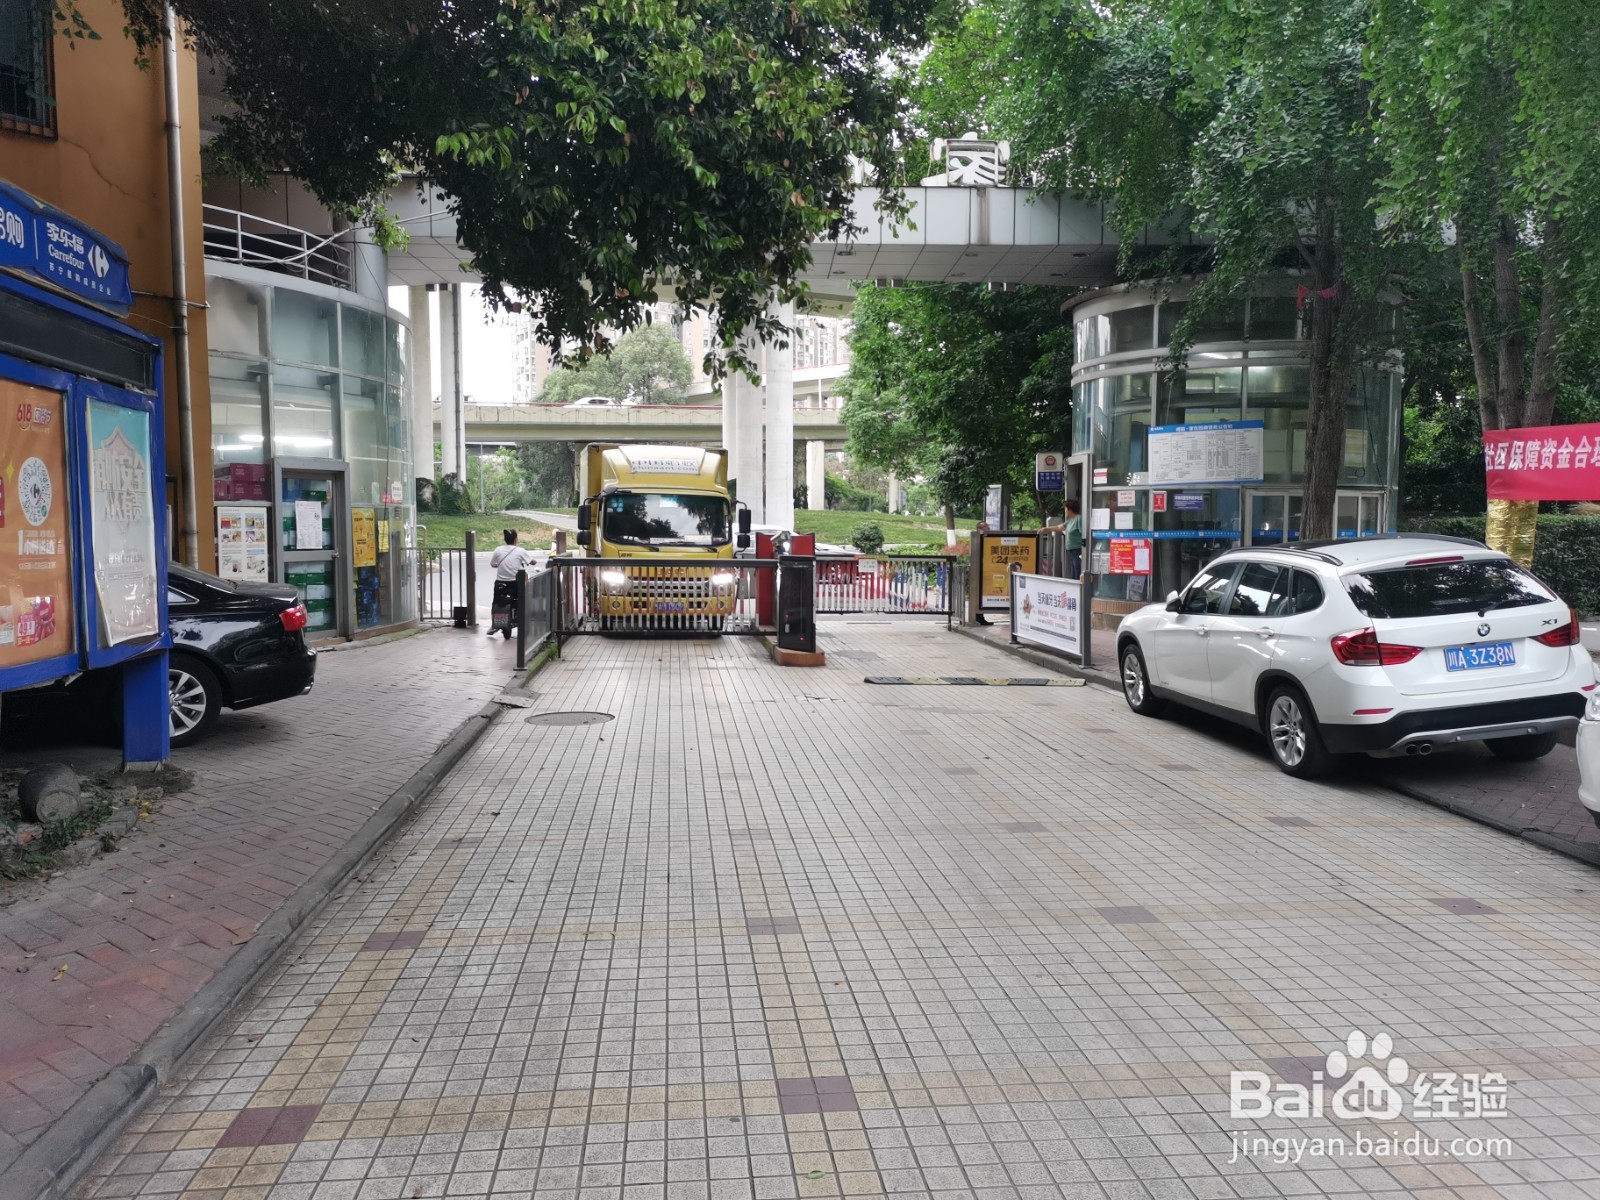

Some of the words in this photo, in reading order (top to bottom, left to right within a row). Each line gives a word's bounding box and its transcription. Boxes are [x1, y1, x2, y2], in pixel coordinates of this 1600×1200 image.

[46, 221, 85, 255] 家乐福
[47, 243, 85, 271] Carrefour
[16, 403, 32, 422] 618
[990, 545, 1030, 556] 美团买药
[1540, 618, 1558, 626] X1
